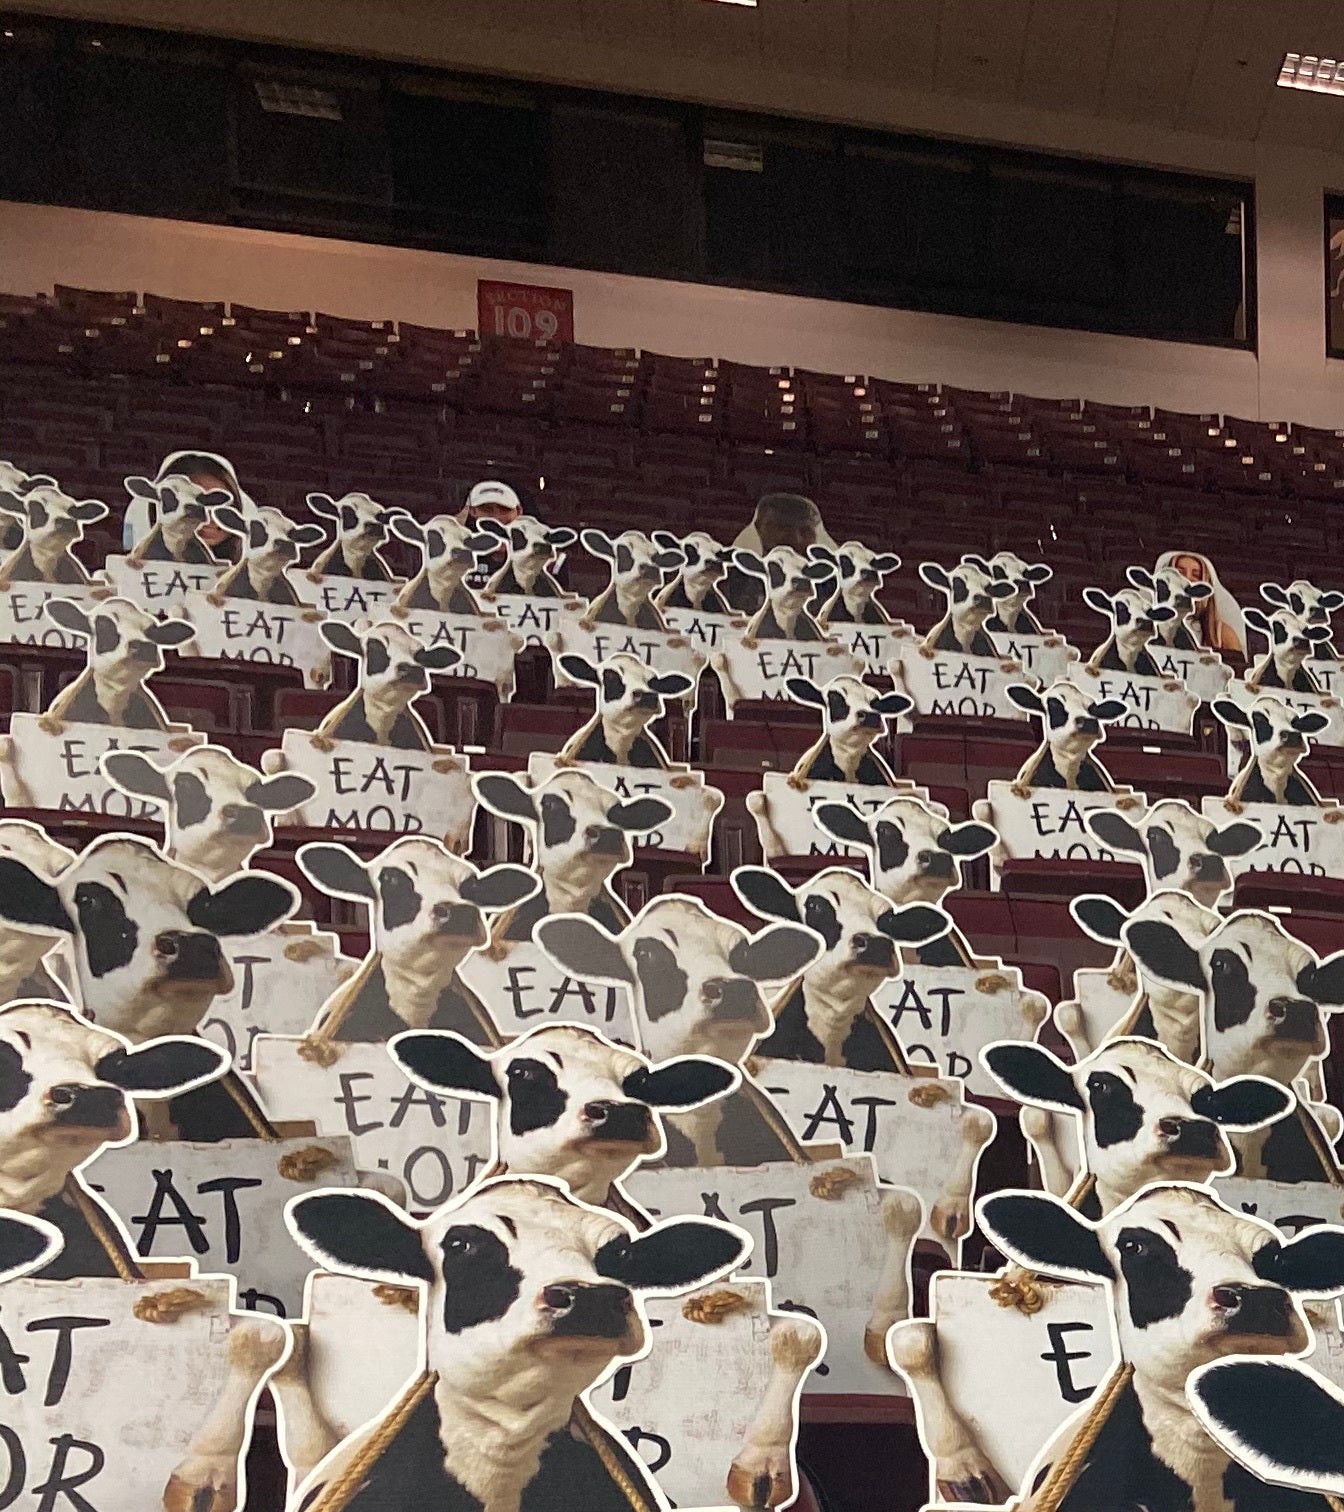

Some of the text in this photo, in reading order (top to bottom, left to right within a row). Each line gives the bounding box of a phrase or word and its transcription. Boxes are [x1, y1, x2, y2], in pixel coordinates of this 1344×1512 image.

[495, 306, 558, 340] 109
[142, 570, 209, 598] EAT
[221, 610, 295, 644] EAT
[667, 618, 724, 646] AT
[850, 632, 886, 658] AT
[1008, 641, 1039, 668] AT
[757, 650, 821, 679] EAT
[932, 662, 994, 694] EAT
[1162, 655, 1195, 681] AT
[329, 756, 424, 801] EAT
[889, 980, 965, 1036] AT
[764, 1084, 896, 1152] AT
[89, 1169, 262, 1264] AT
